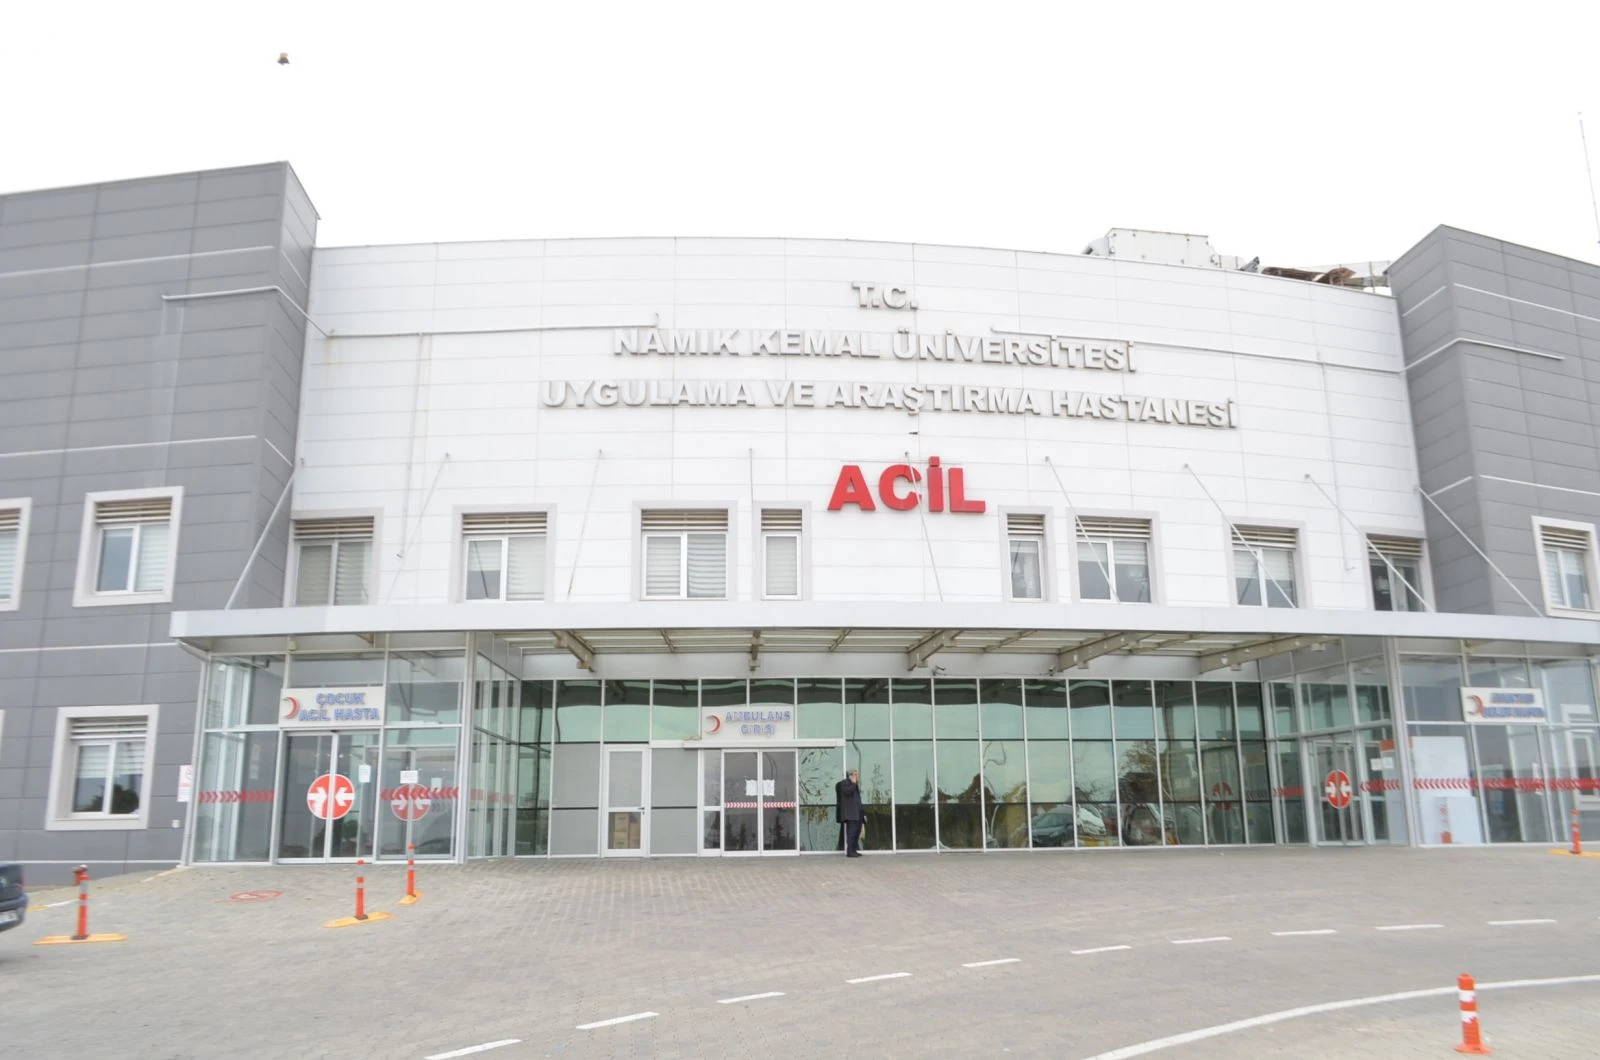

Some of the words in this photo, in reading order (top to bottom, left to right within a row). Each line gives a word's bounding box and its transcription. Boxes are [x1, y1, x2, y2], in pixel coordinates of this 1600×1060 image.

[852, 281, 919, 310] T.C.
[613, 328, 739, 357] NAMIK
[752, 329, 880, 358] KEMAL
[891, 327, 1137, 373] ÜNİVERSİTESİ
[541, 379, 756, 408] UYGULAMA
[765, 380, 815, 408] VE
[825, 382, 1040, 416] ARAŞTIRMA
[1048, 389, 1237, 429] HASTANESİ
[827, 455, 986, 513] ACİL
[334, 708, 379, 721] HASTA
[725, 711, 792, 722] AMBULANS
